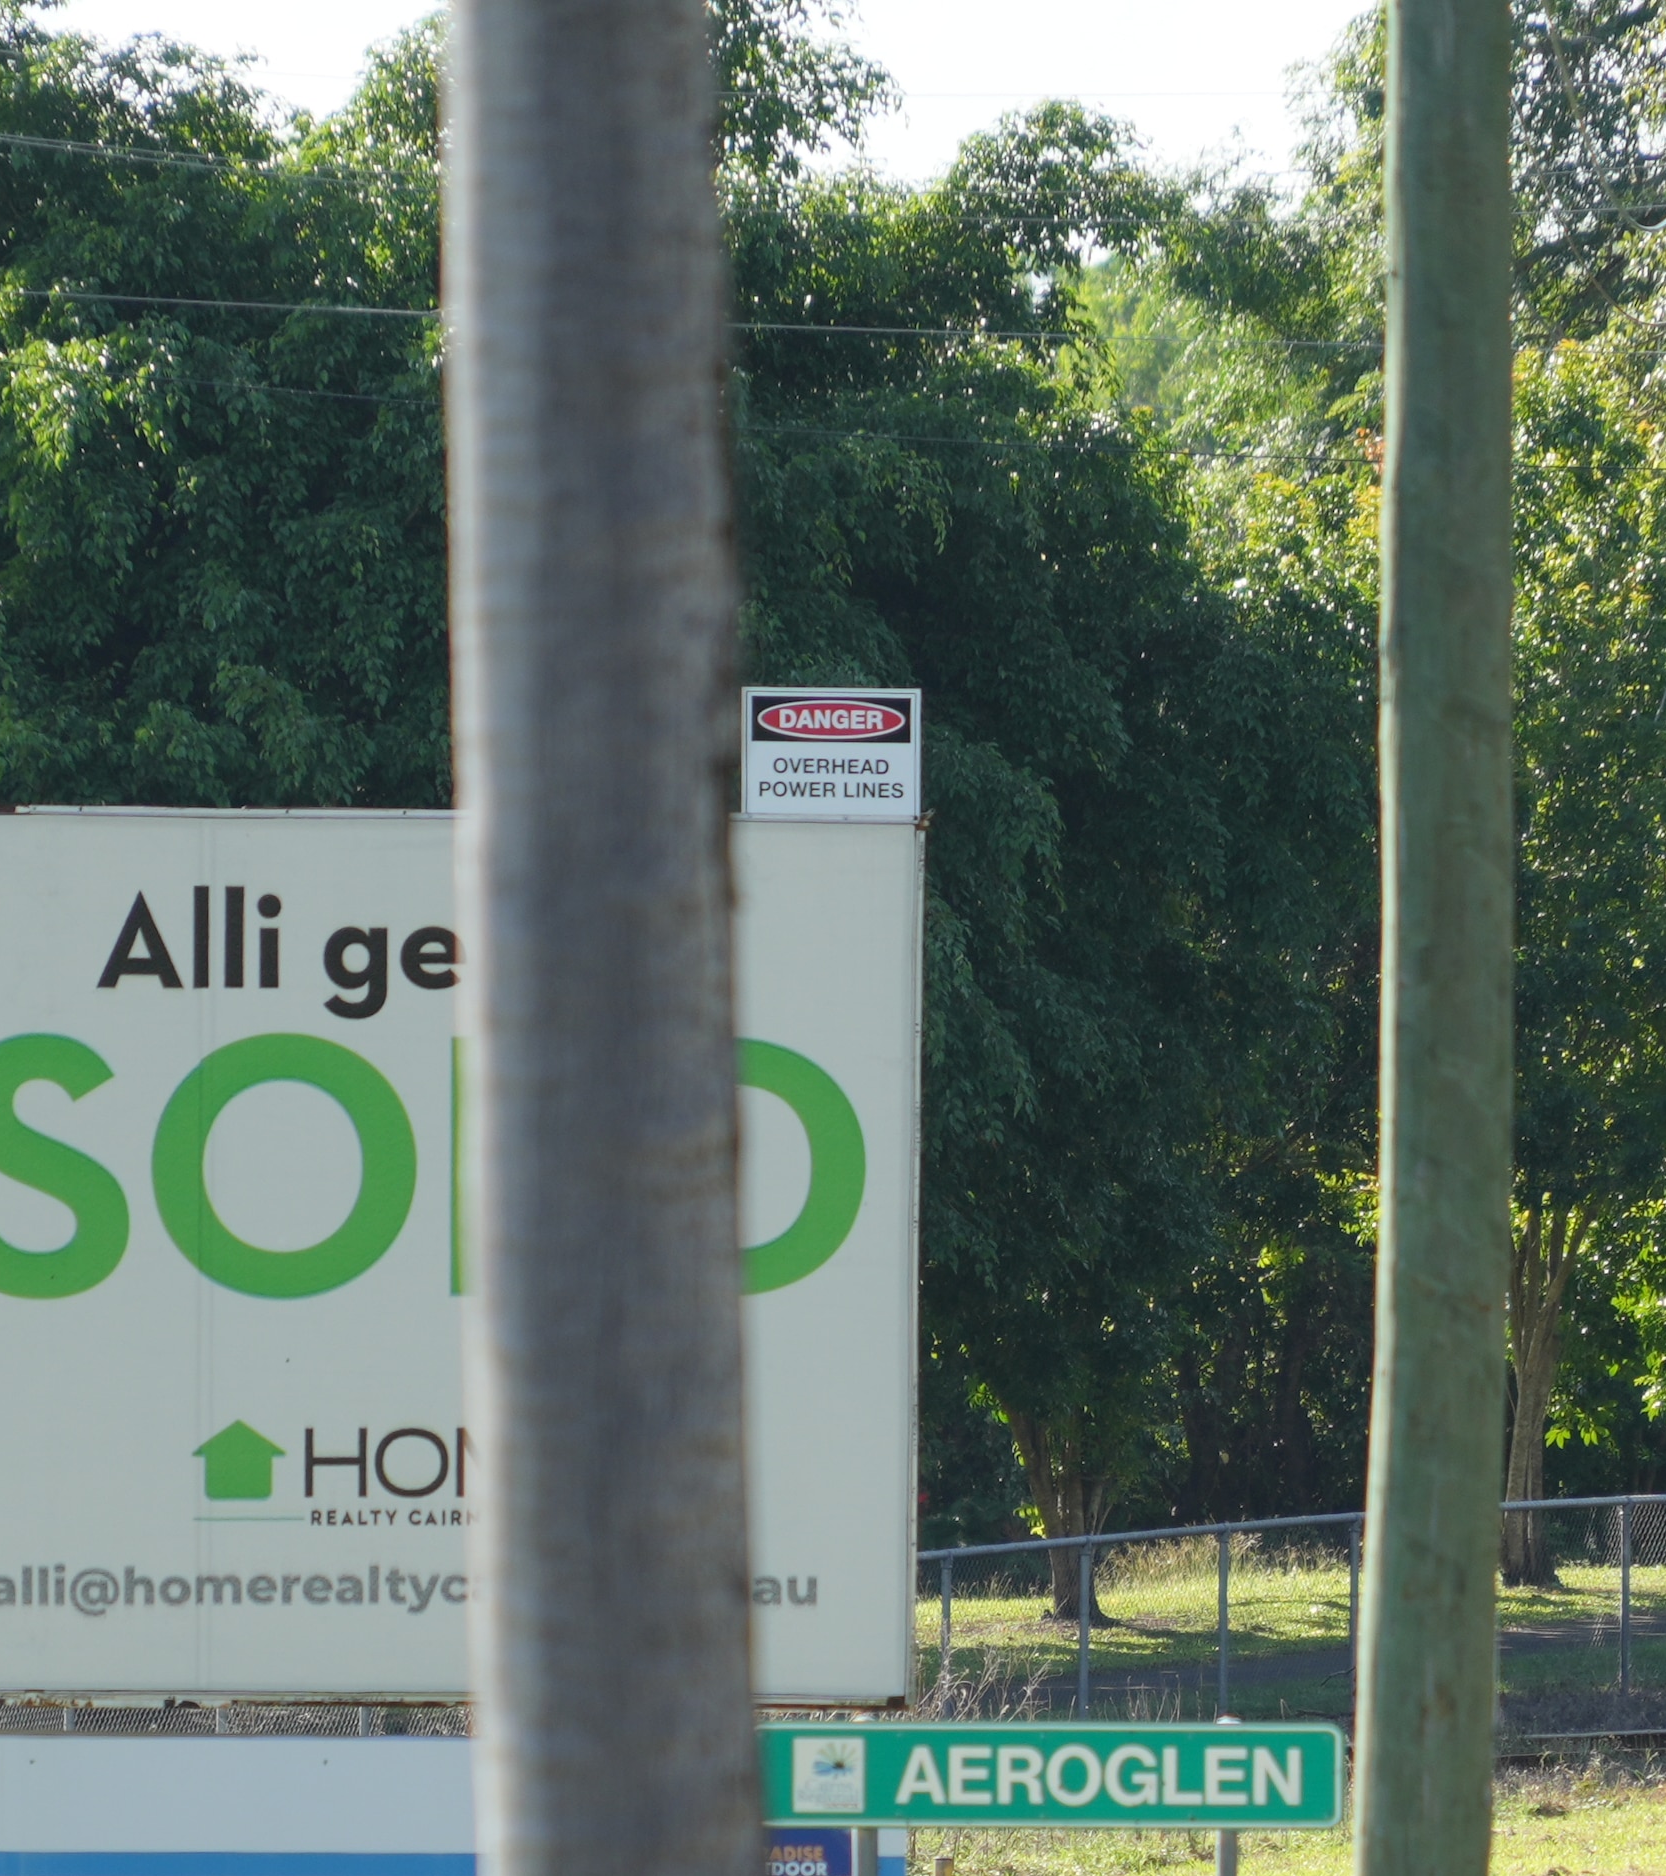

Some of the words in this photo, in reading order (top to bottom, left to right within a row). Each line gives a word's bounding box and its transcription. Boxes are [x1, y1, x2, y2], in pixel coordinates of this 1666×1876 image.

[779, 708, 883, 730] DANGER
[773, 757, 889, 775] OVERHEAD
[759, 781, 836, 798] POWER
[843, 782, 904, 799] LINES
[96, 885, 282, 989] Alli
[323, 924, 467, 1020] ge
[304, 1427, 481, 1498] HO
[310, 1510, 398, 1526] REALTY
[895, 1744, 1302, 1807] AEROGLEN
[767, 1845, 824, 1861] ADISE
[765, 1861, 828, 1876] TDOOR
